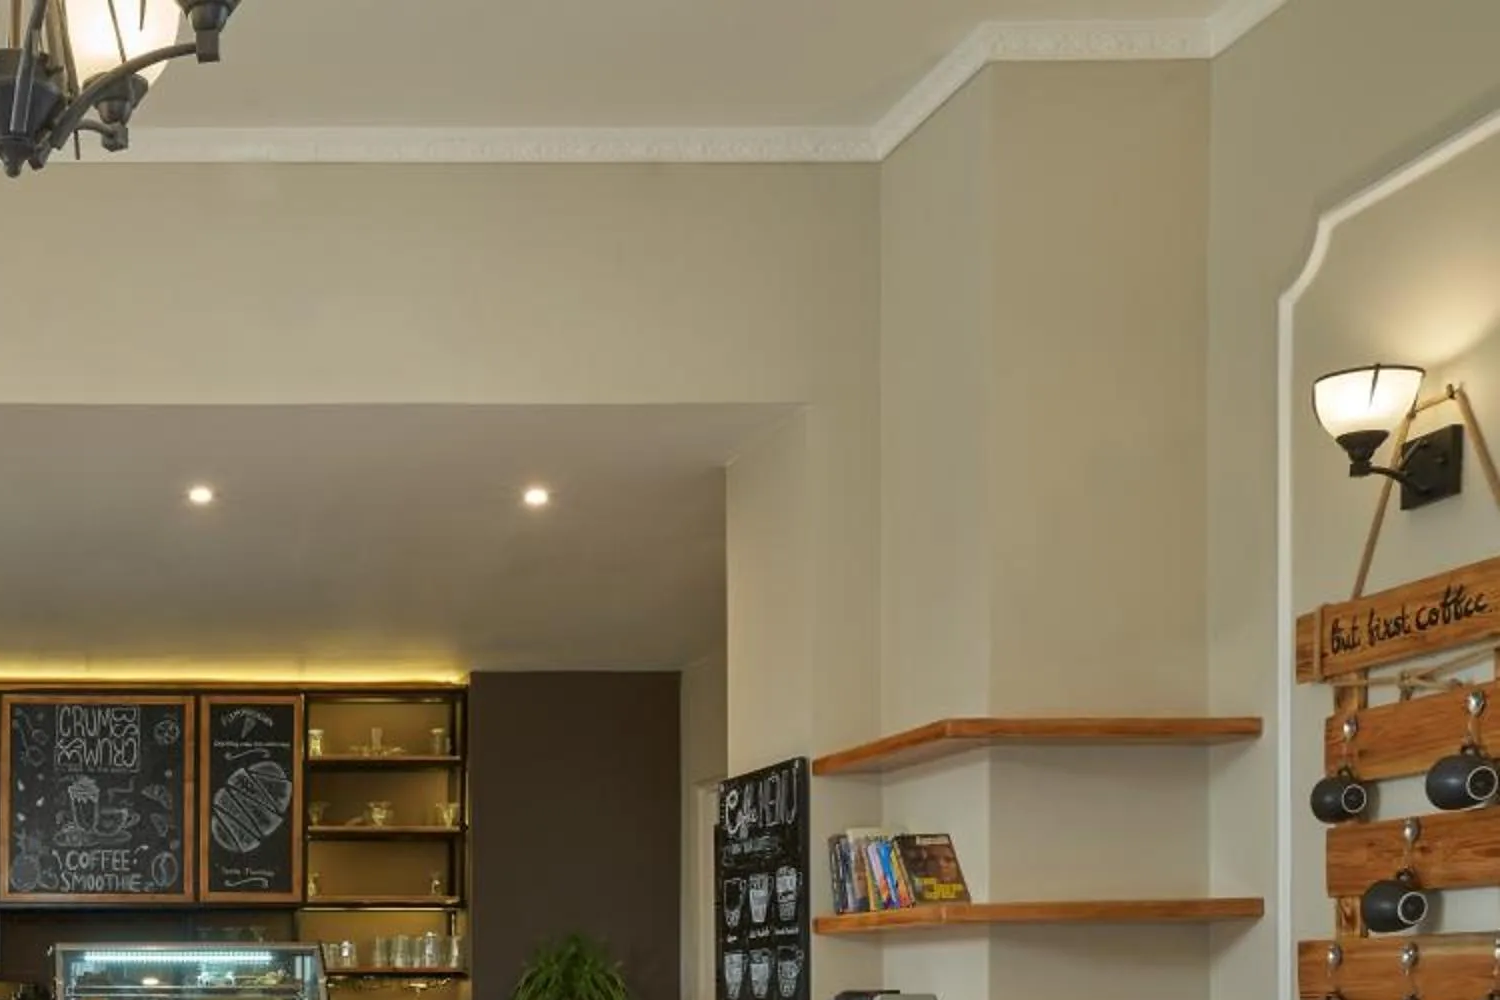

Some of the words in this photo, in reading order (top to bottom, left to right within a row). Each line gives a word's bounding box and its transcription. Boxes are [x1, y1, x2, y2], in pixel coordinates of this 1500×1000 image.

[1331, 618, 1361, 655] but
[1367, 606, 1411, 647] first
[66, 849, 131, 871] COFFEE
